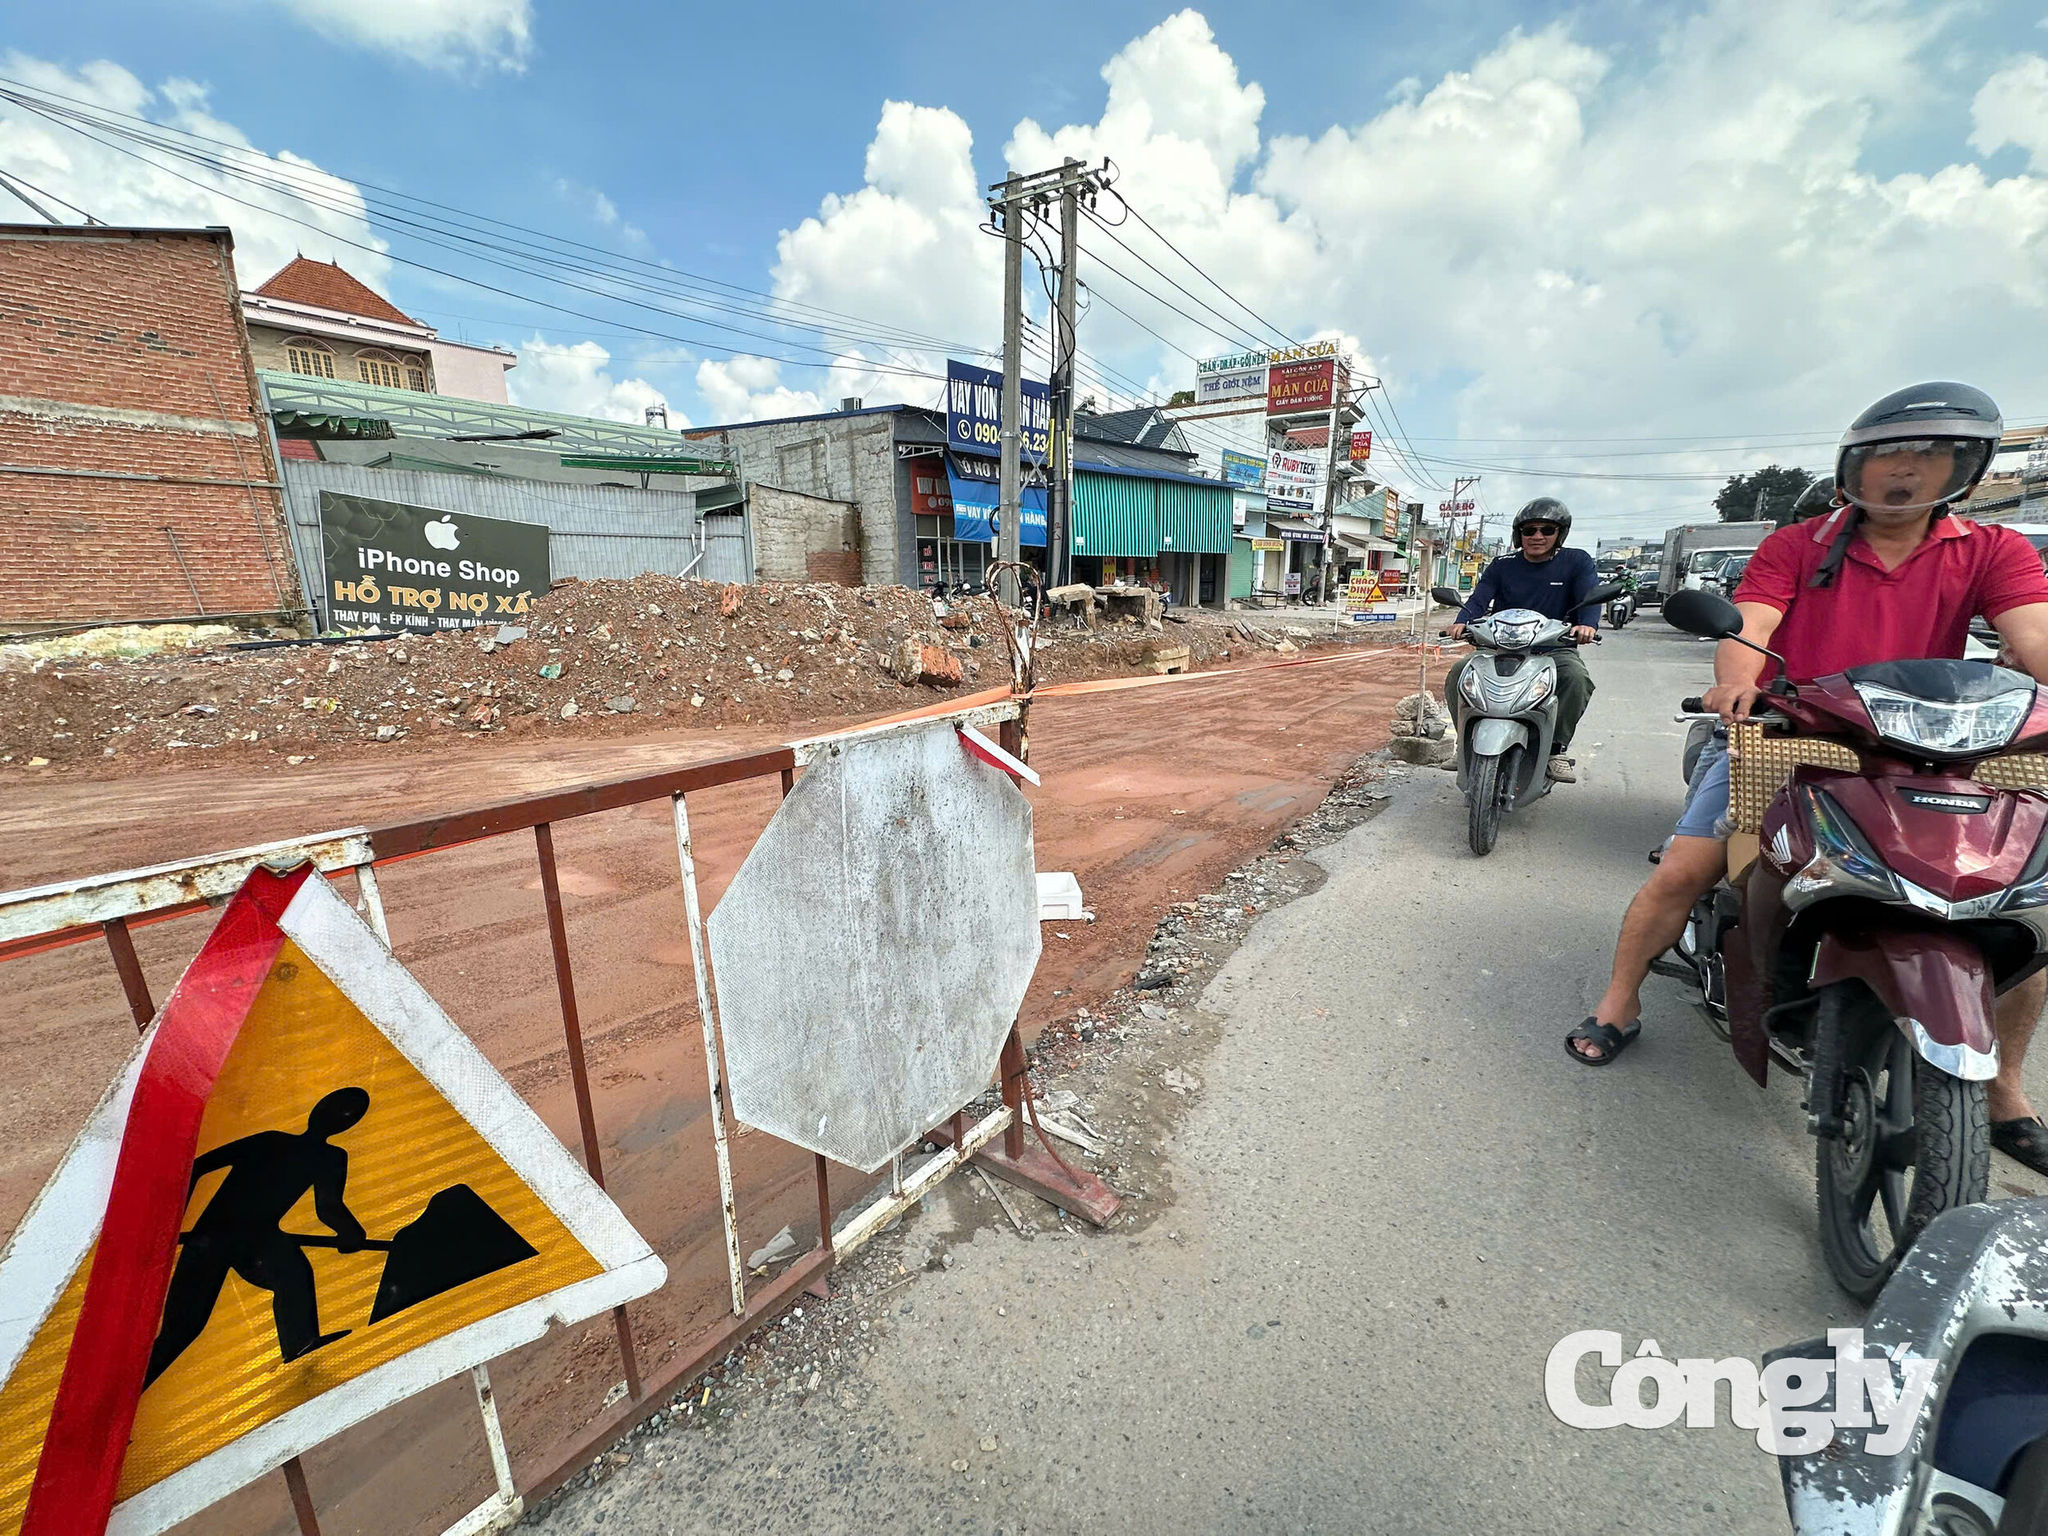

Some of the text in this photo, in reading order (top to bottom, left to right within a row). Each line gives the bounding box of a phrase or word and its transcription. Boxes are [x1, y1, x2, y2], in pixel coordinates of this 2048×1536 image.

[950, 378, 971, 415] VAY
[974, 375, 997, 420] VỐN
[1271, 380, 1300, 398] MÀN
[1304, 375, 1329, 394] CỬA
[967, 505, 981, 519] VAY
[358, 547, 520, 587] iPhone Shop
[334, 575, 539, 616] HỖ TRỢ NỢ XẤ
[333, 609, 359, 623] THAY
[362, 611, 380, 624] PIN
[390, 611, 402, 625] ÉP
[405, 613, 428, 627] KÍNH
[437, 617, 462, 628] THAY
[1911, 795, 1981, 809] HONDA
